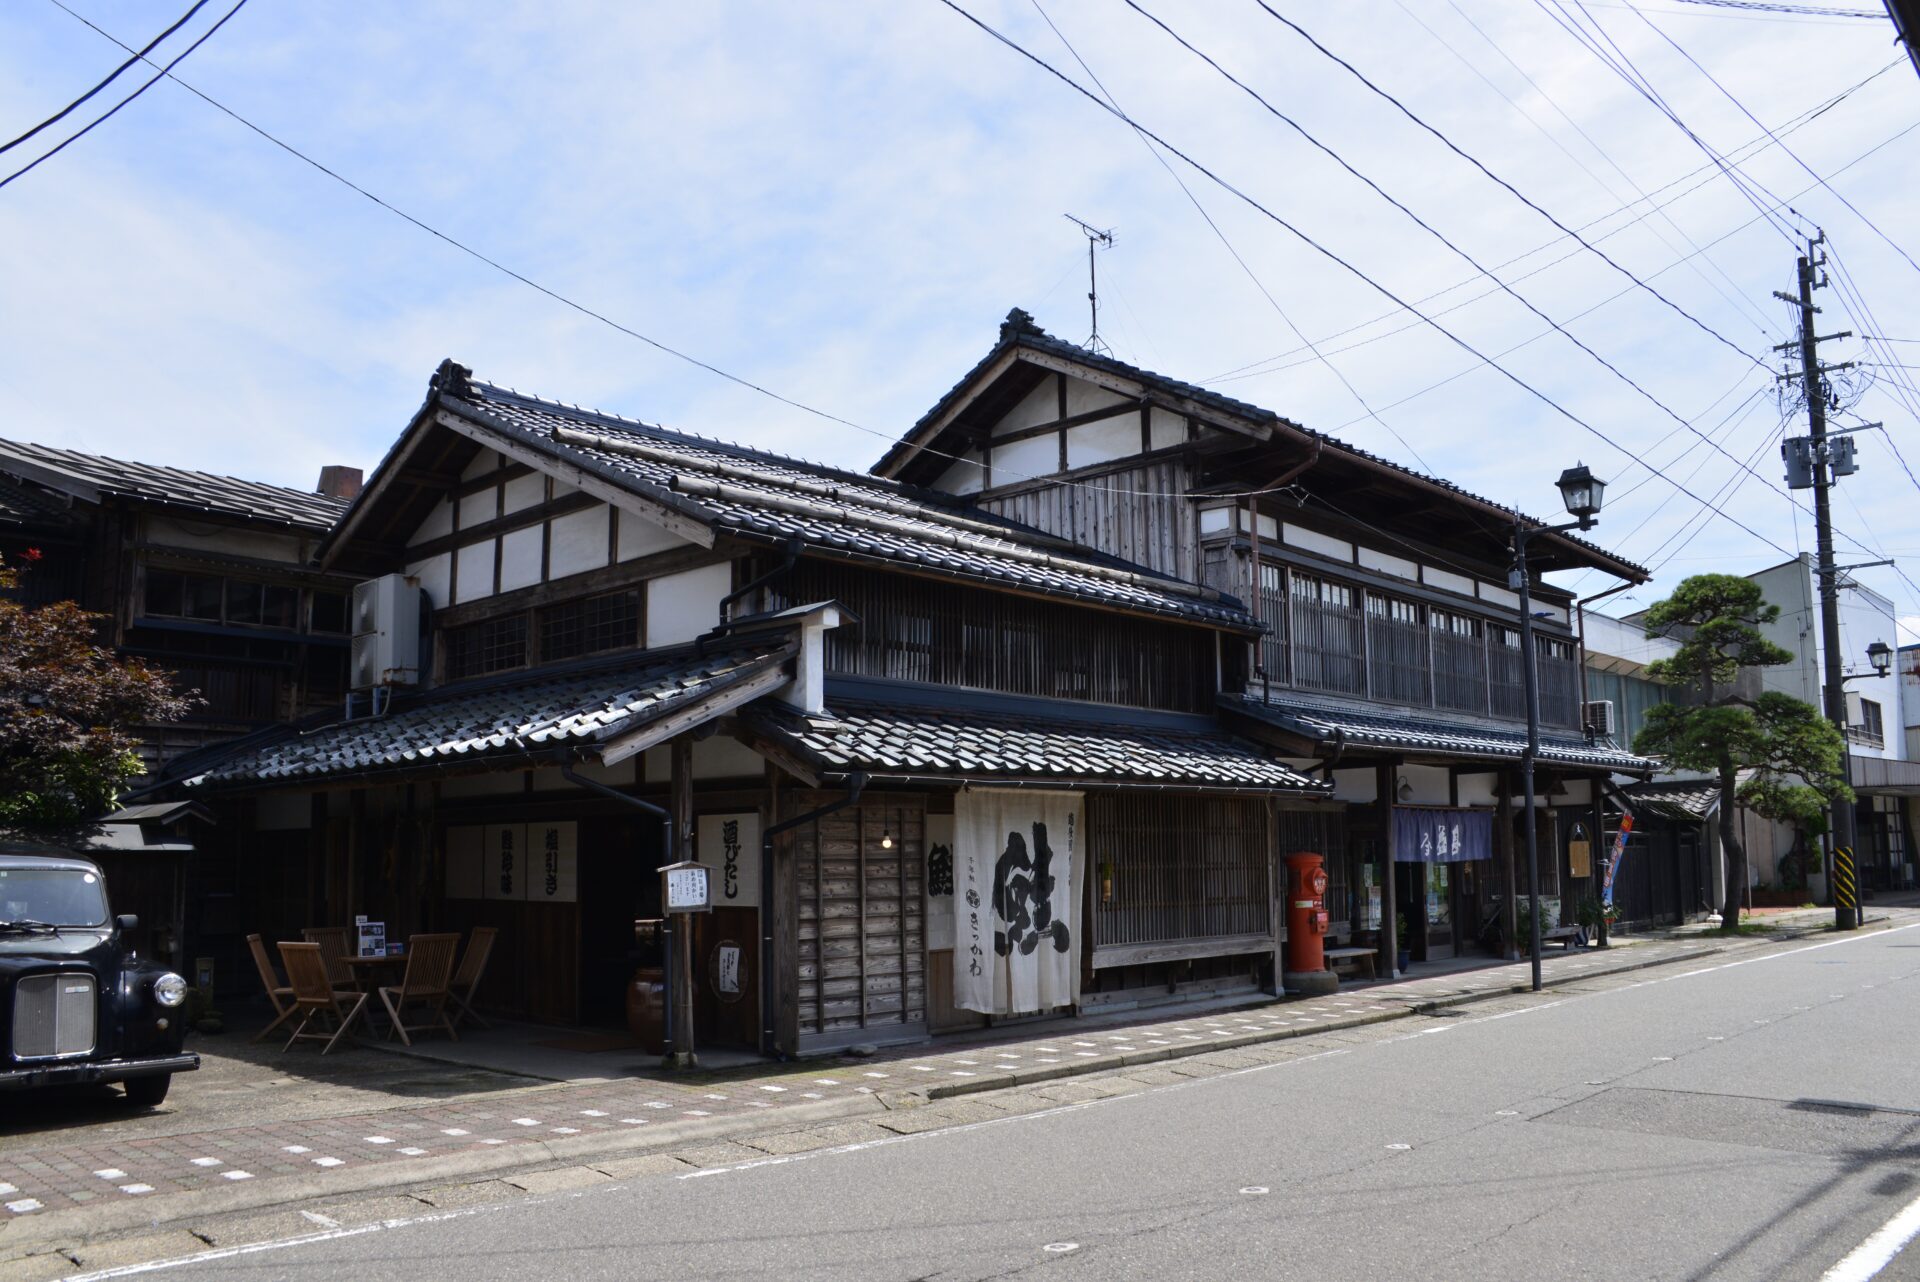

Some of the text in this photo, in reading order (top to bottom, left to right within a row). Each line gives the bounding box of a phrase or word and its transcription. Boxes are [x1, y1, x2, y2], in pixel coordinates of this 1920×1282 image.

[723, 820, 741, 898] 酒びたし
[969, 912, 983, 976] きっかわ
